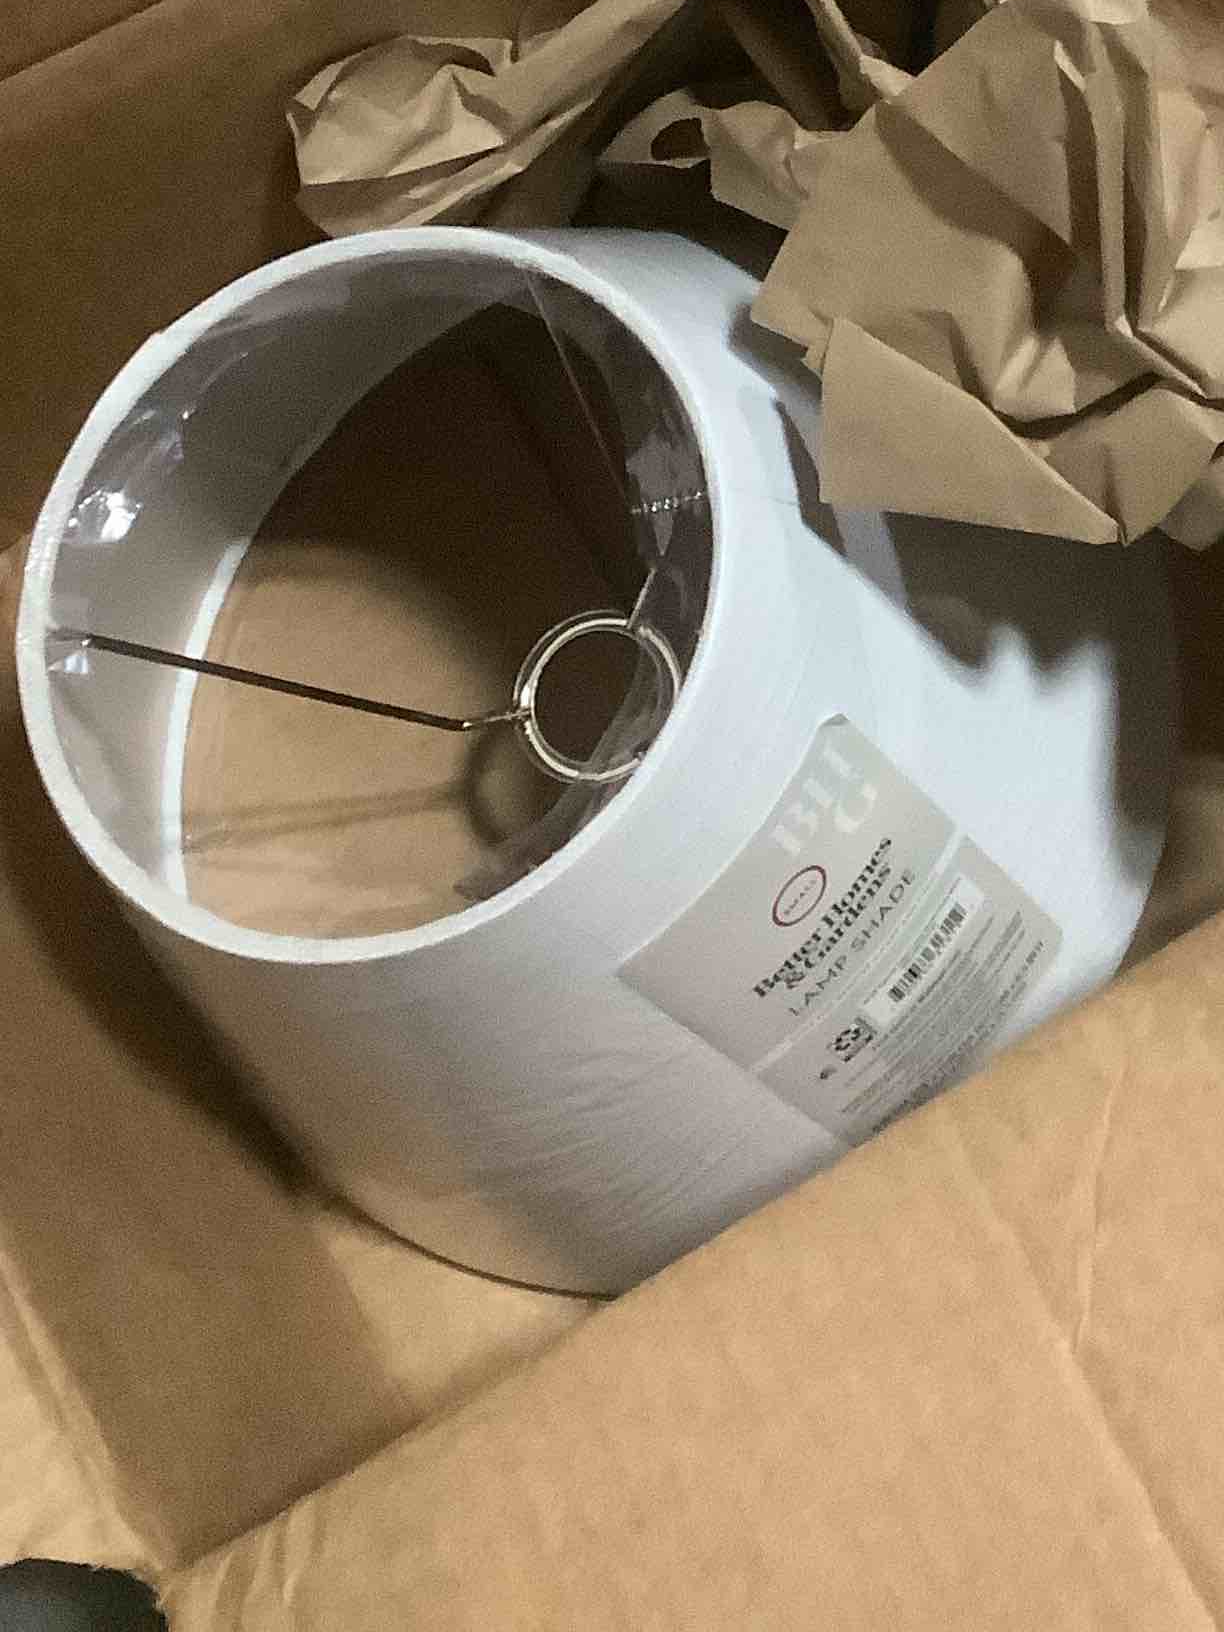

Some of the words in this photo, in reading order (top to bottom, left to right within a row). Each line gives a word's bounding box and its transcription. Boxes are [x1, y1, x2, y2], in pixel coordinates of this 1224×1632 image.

[752, 927, 822, 998] Better
[821, 837, 892, 928] Homes
[788, 954, 848, 1016] LAMP
[850, 868, 916, 953] SHADE
[803, 864, 892, 970] Gardens
